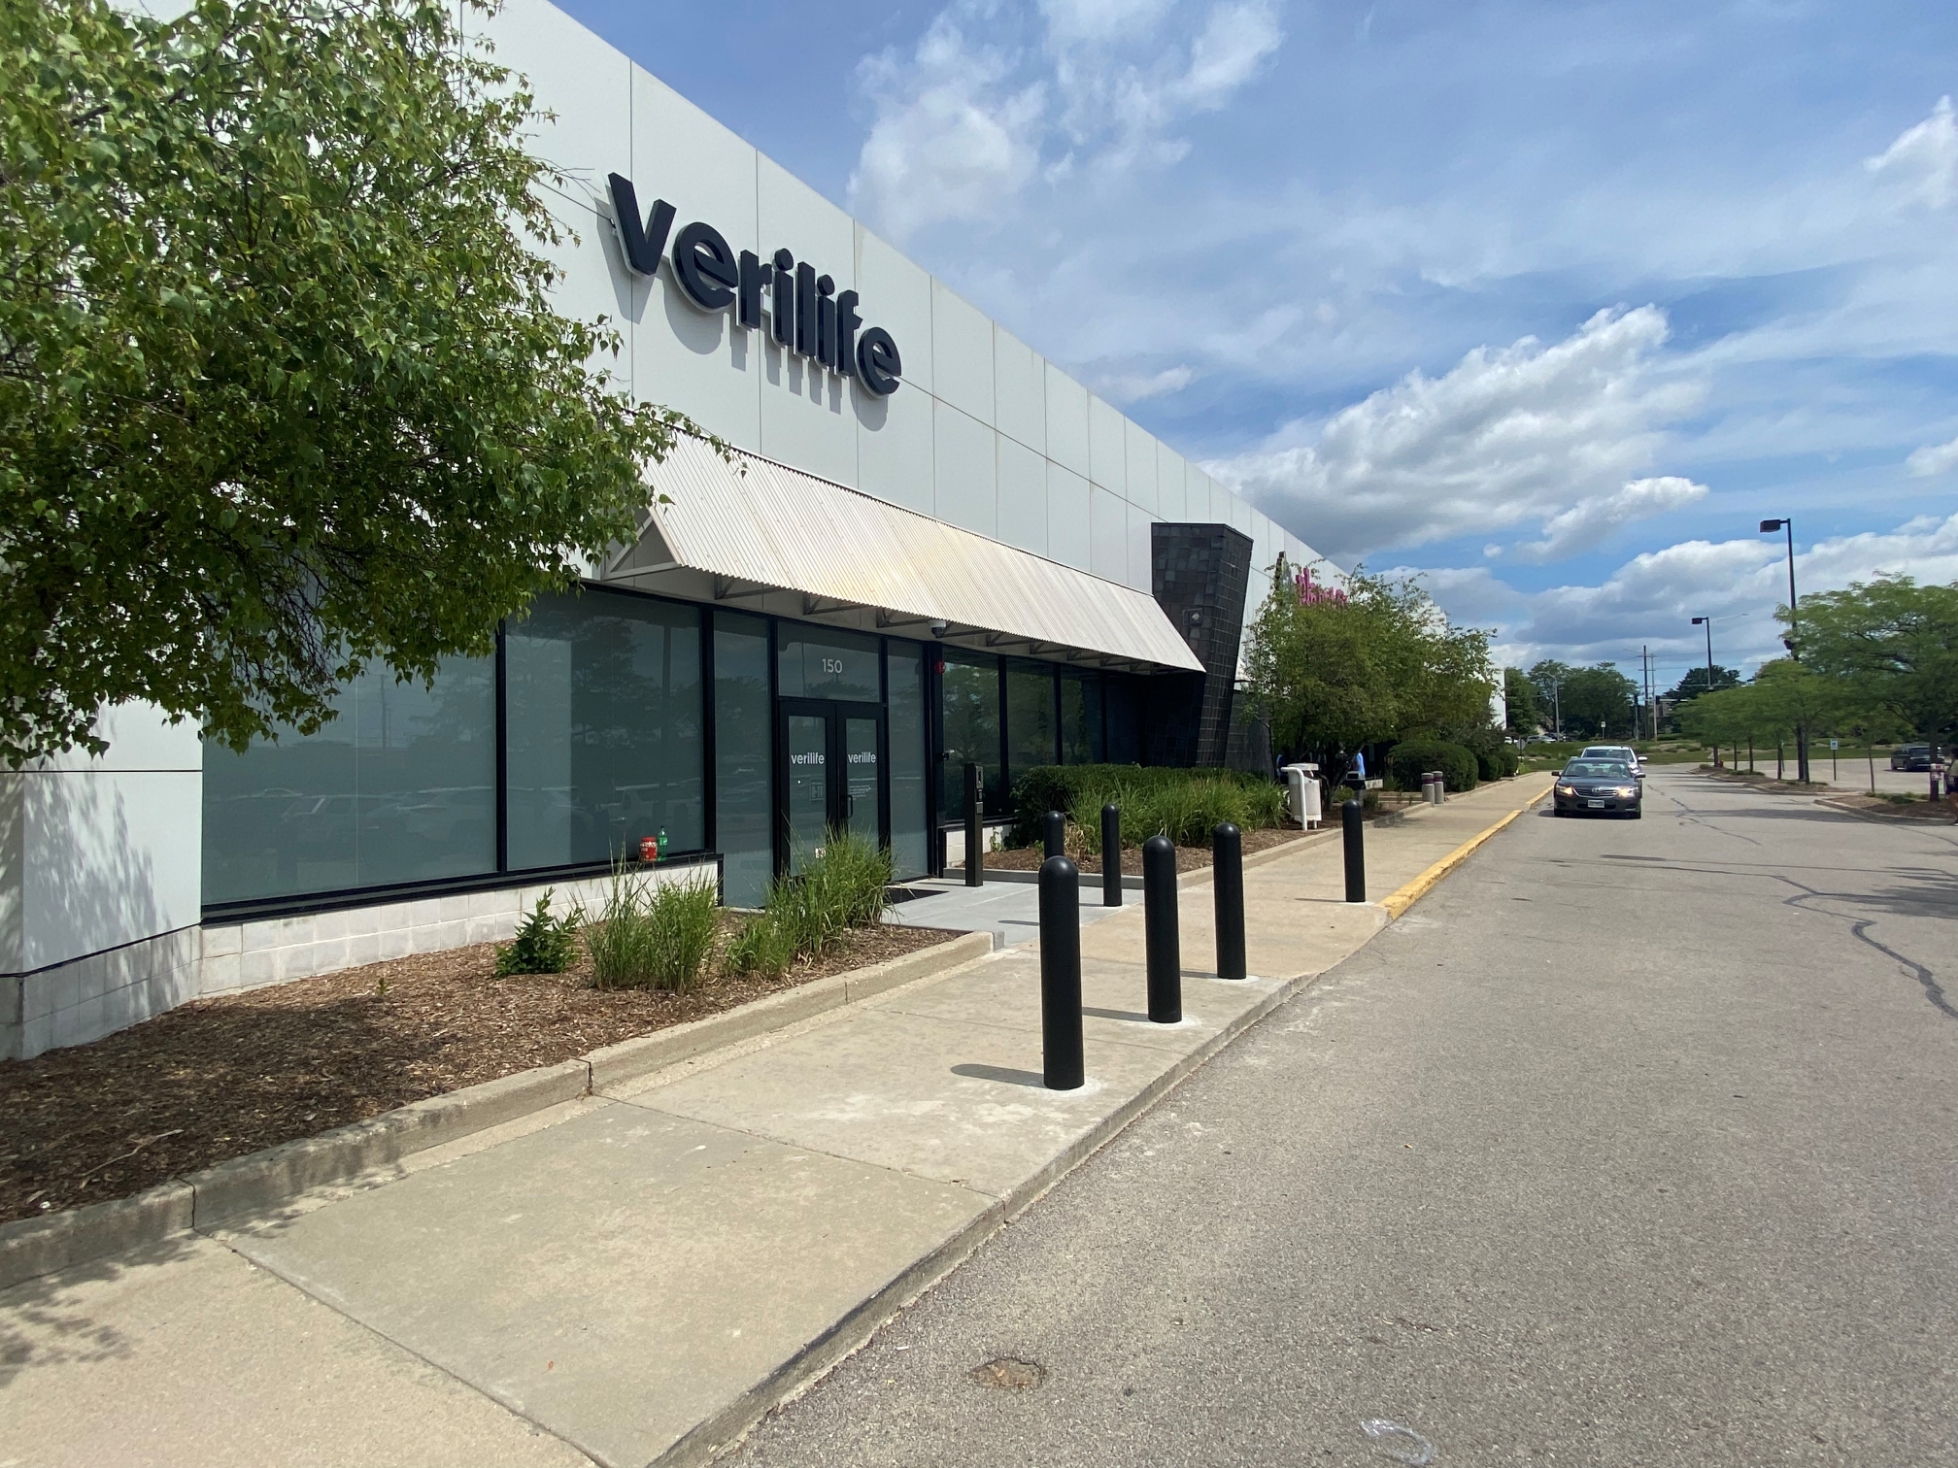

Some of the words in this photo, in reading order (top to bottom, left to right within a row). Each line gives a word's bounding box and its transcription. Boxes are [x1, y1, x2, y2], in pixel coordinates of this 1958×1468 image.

[607, 171, 902, 397] verilife
[821, 658, 843, 674] 150
[791, 751, 825, 765] verilife
[848, 751, 877, 764] verilife
